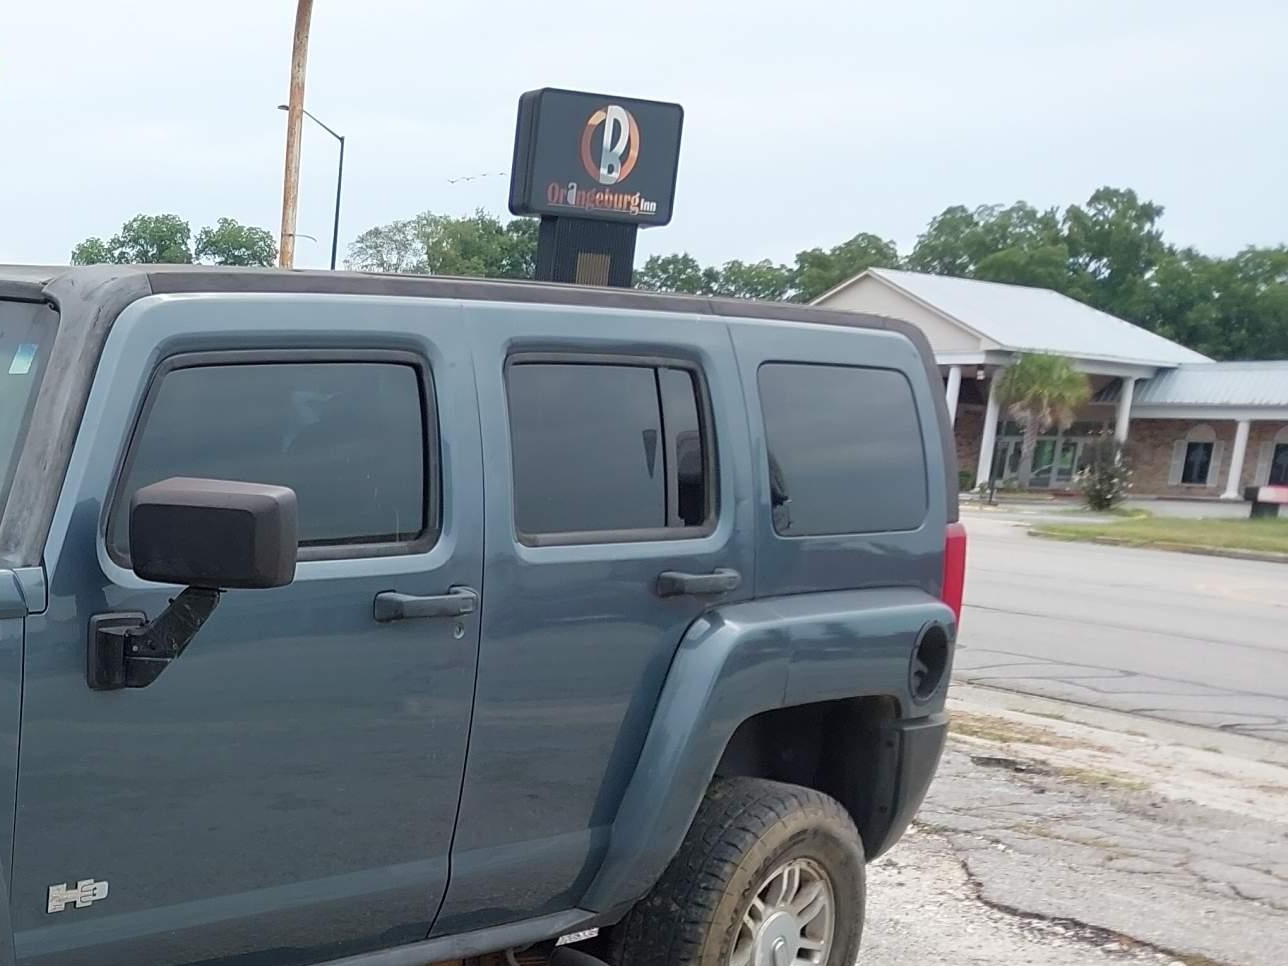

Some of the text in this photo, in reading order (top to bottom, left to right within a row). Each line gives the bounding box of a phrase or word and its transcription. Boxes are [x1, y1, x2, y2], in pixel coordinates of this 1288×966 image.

[547, 182, 657, 215] Orangeburg Inn
[47, 879, 108, 913] H3
